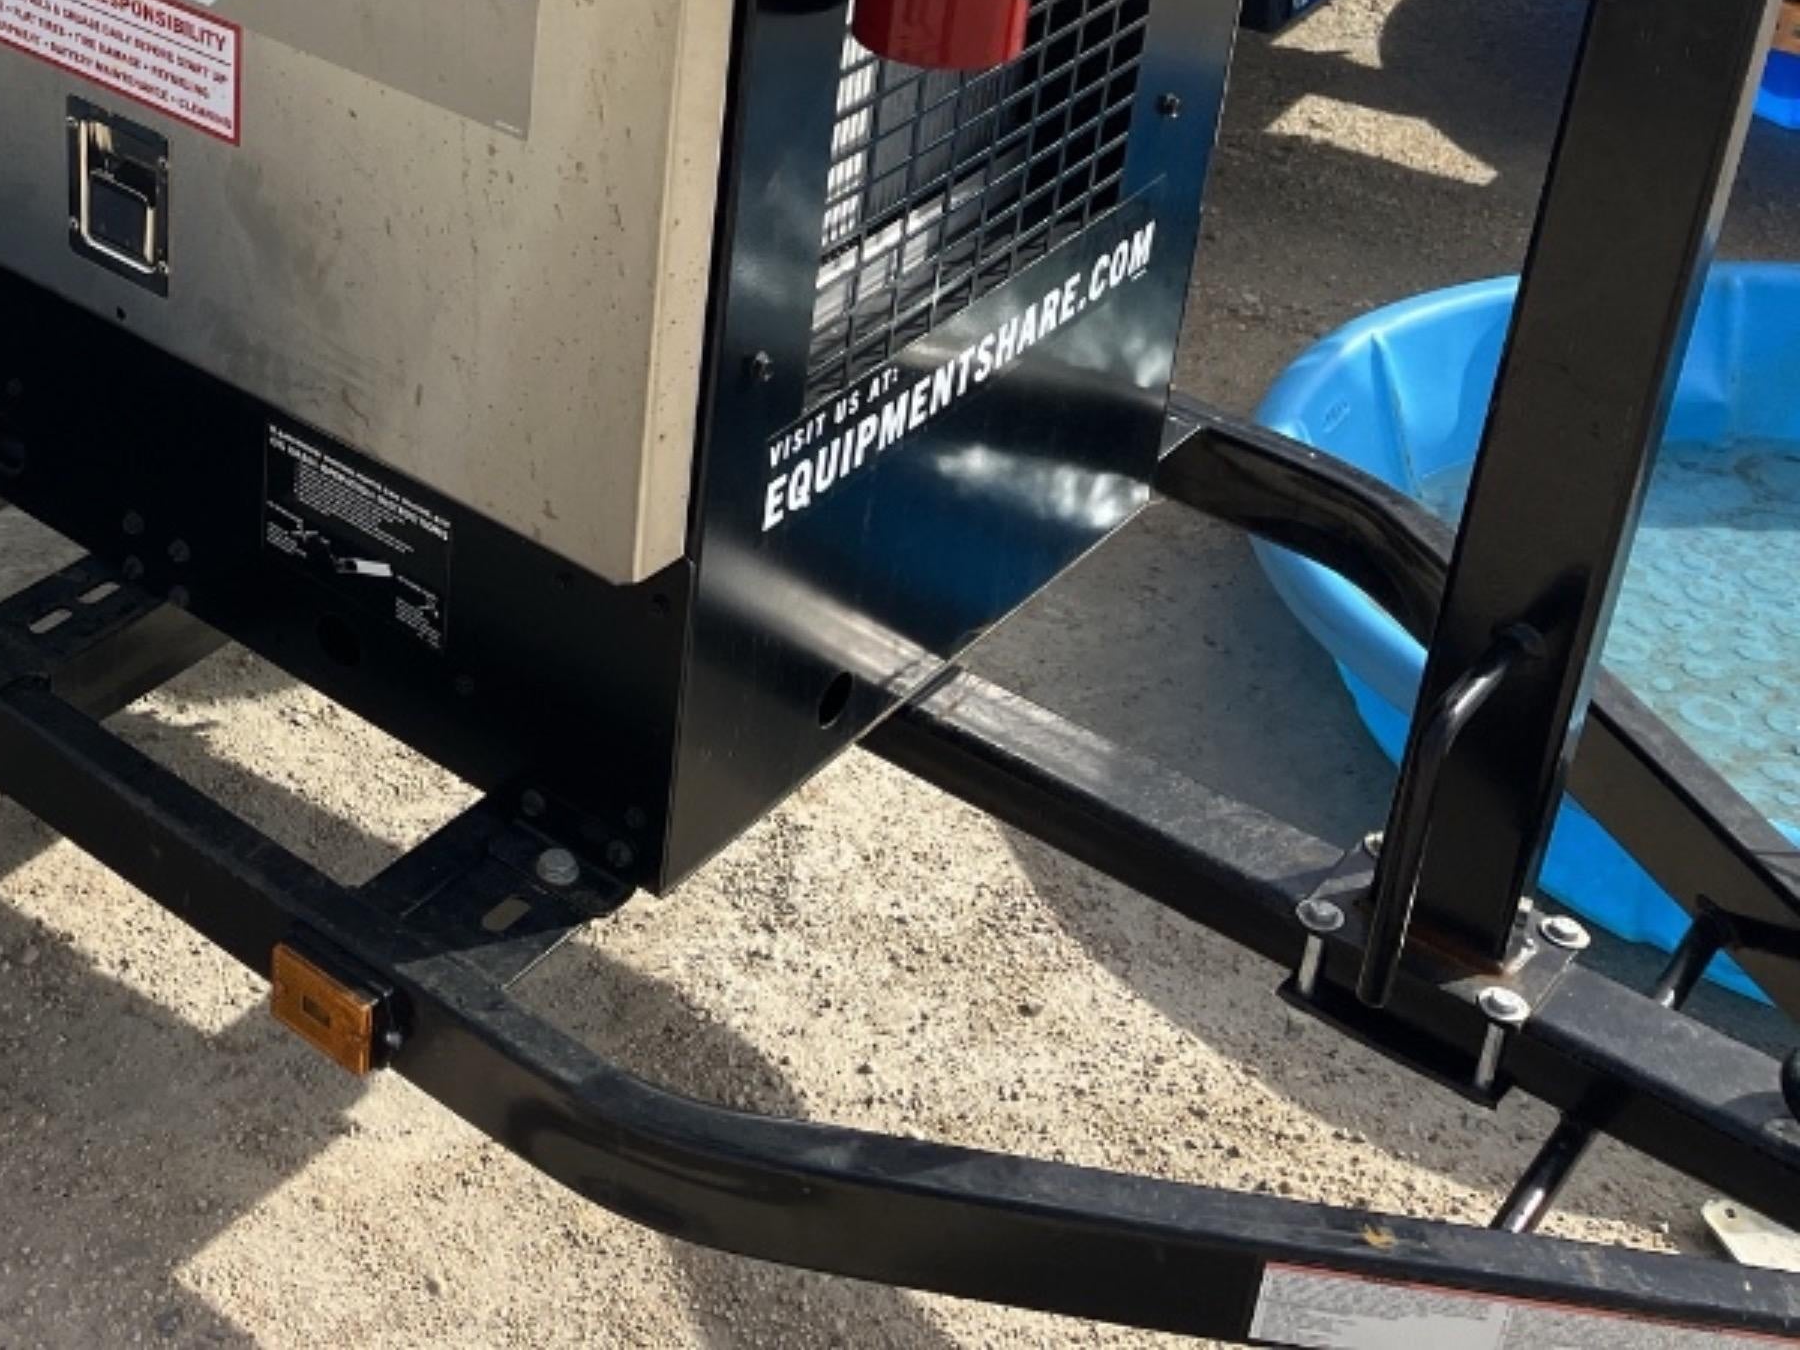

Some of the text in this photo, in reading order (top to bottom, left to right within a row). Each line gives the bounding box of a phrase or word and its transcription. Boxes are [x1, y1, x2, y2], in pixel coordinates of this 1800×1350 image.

[760, 219, 1156, 534] EQUIPMENTSHARE.COM
[767, 366, 900, 469] VISIT US AT:
